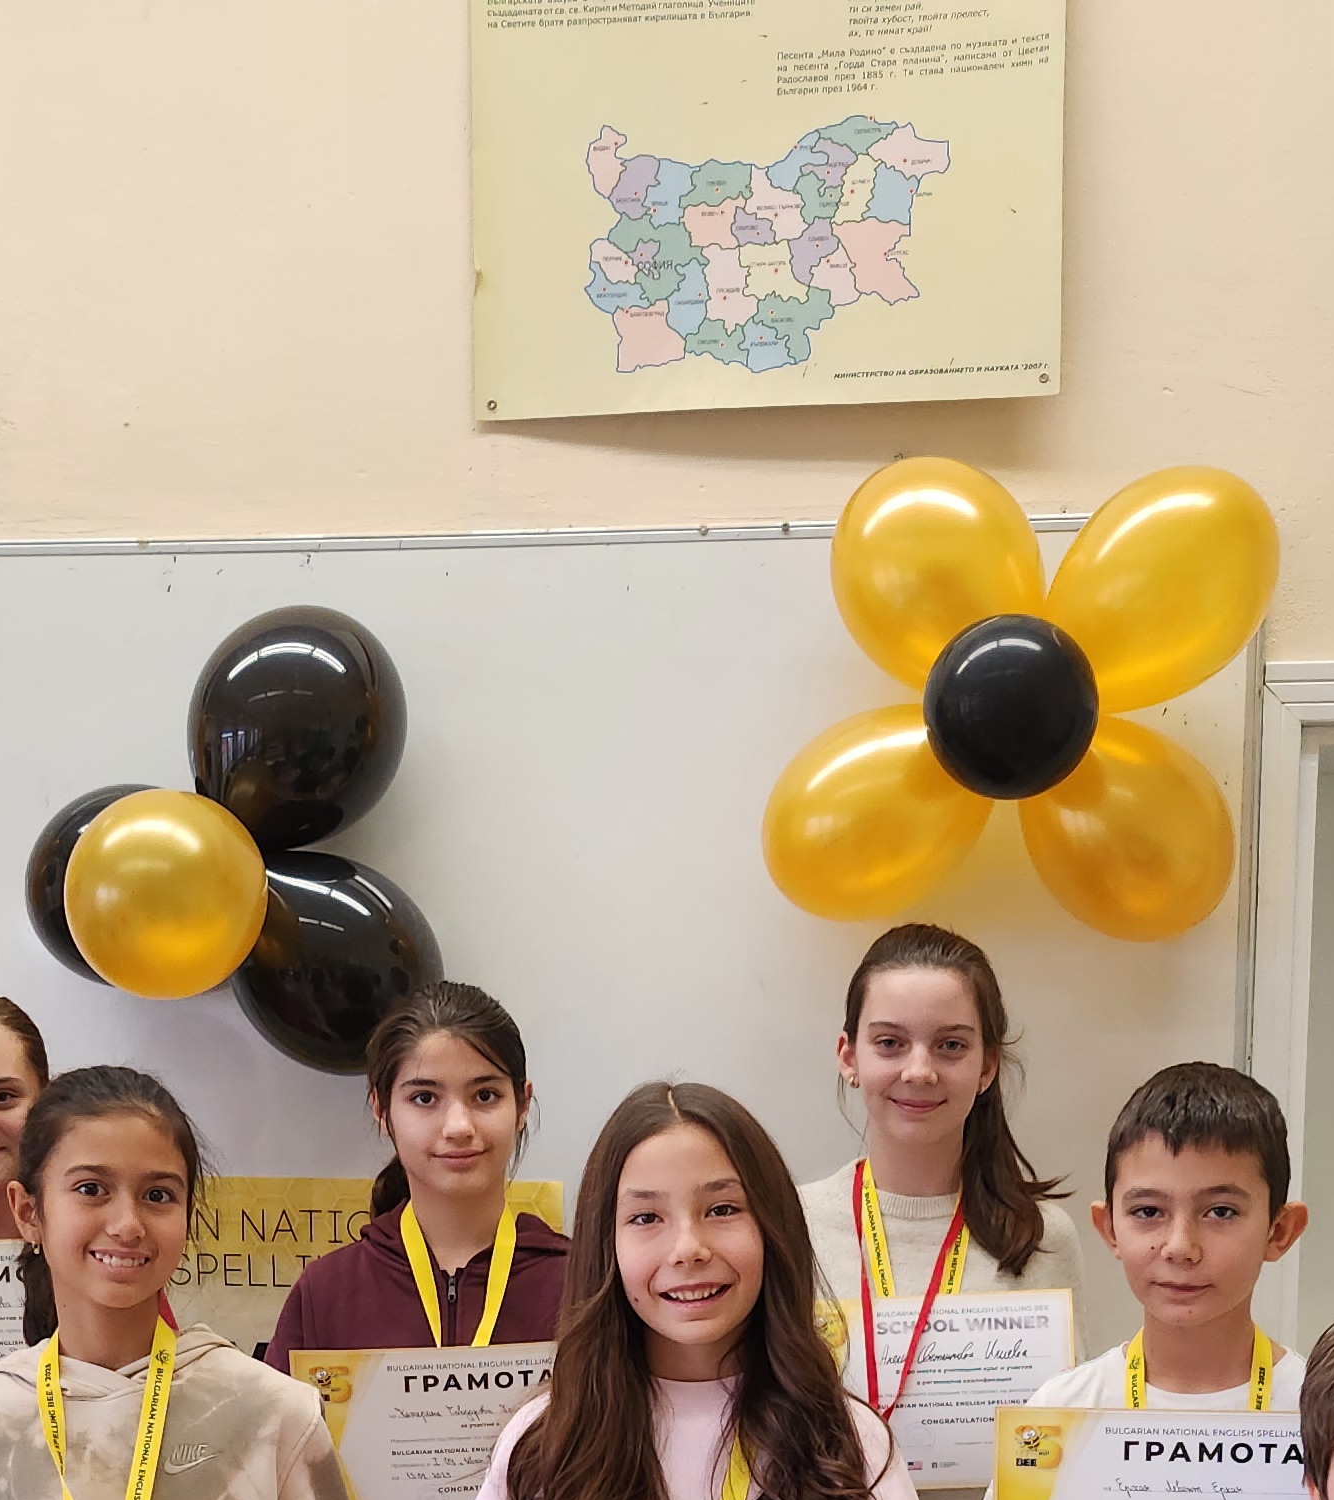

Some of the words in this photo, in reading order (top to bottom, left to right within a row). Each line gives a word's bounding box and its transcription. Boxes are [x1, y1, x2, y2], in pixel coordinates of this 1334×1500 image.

[584, 5, 611, 14] Кирил
[619, 3, 657, 12] Методий
[501, 19, 536, 28] Светите
[539, 18, 564, 28] братя
[567, 14, 642, 28] разпространяват
[849, 15, 879, 26] твойта
[777, 51, 814, 61] Песента
[793, 62, 829, 72] песента
[870, 57, 897, 69] Стара
[846, 82, 868, 93] 1964
[241, 1208, 371, 1244] NATIO
[169, 1253, 321, 1287] SPELL
[966, 1315, 1050, 1331] WINNER
[46, 1390, 55, 1408] BEE
[149, 1367, 164, 1420] BULGARIAN
[921, 1416, 995, 1426] CONGRATULATION
[1105, 1426, 1160, 1435] BULGARIAN
[1162, 1427, 1210, 1436] NATIONAL
[1213, 1428, 1254, 1438] ENGLISH
[140, 1421, 155, 1468] NATIONAL
[172, 1444, 208, 1462] NIKE
[1123, 1440, 1305, 1465] ГРАМОТА
